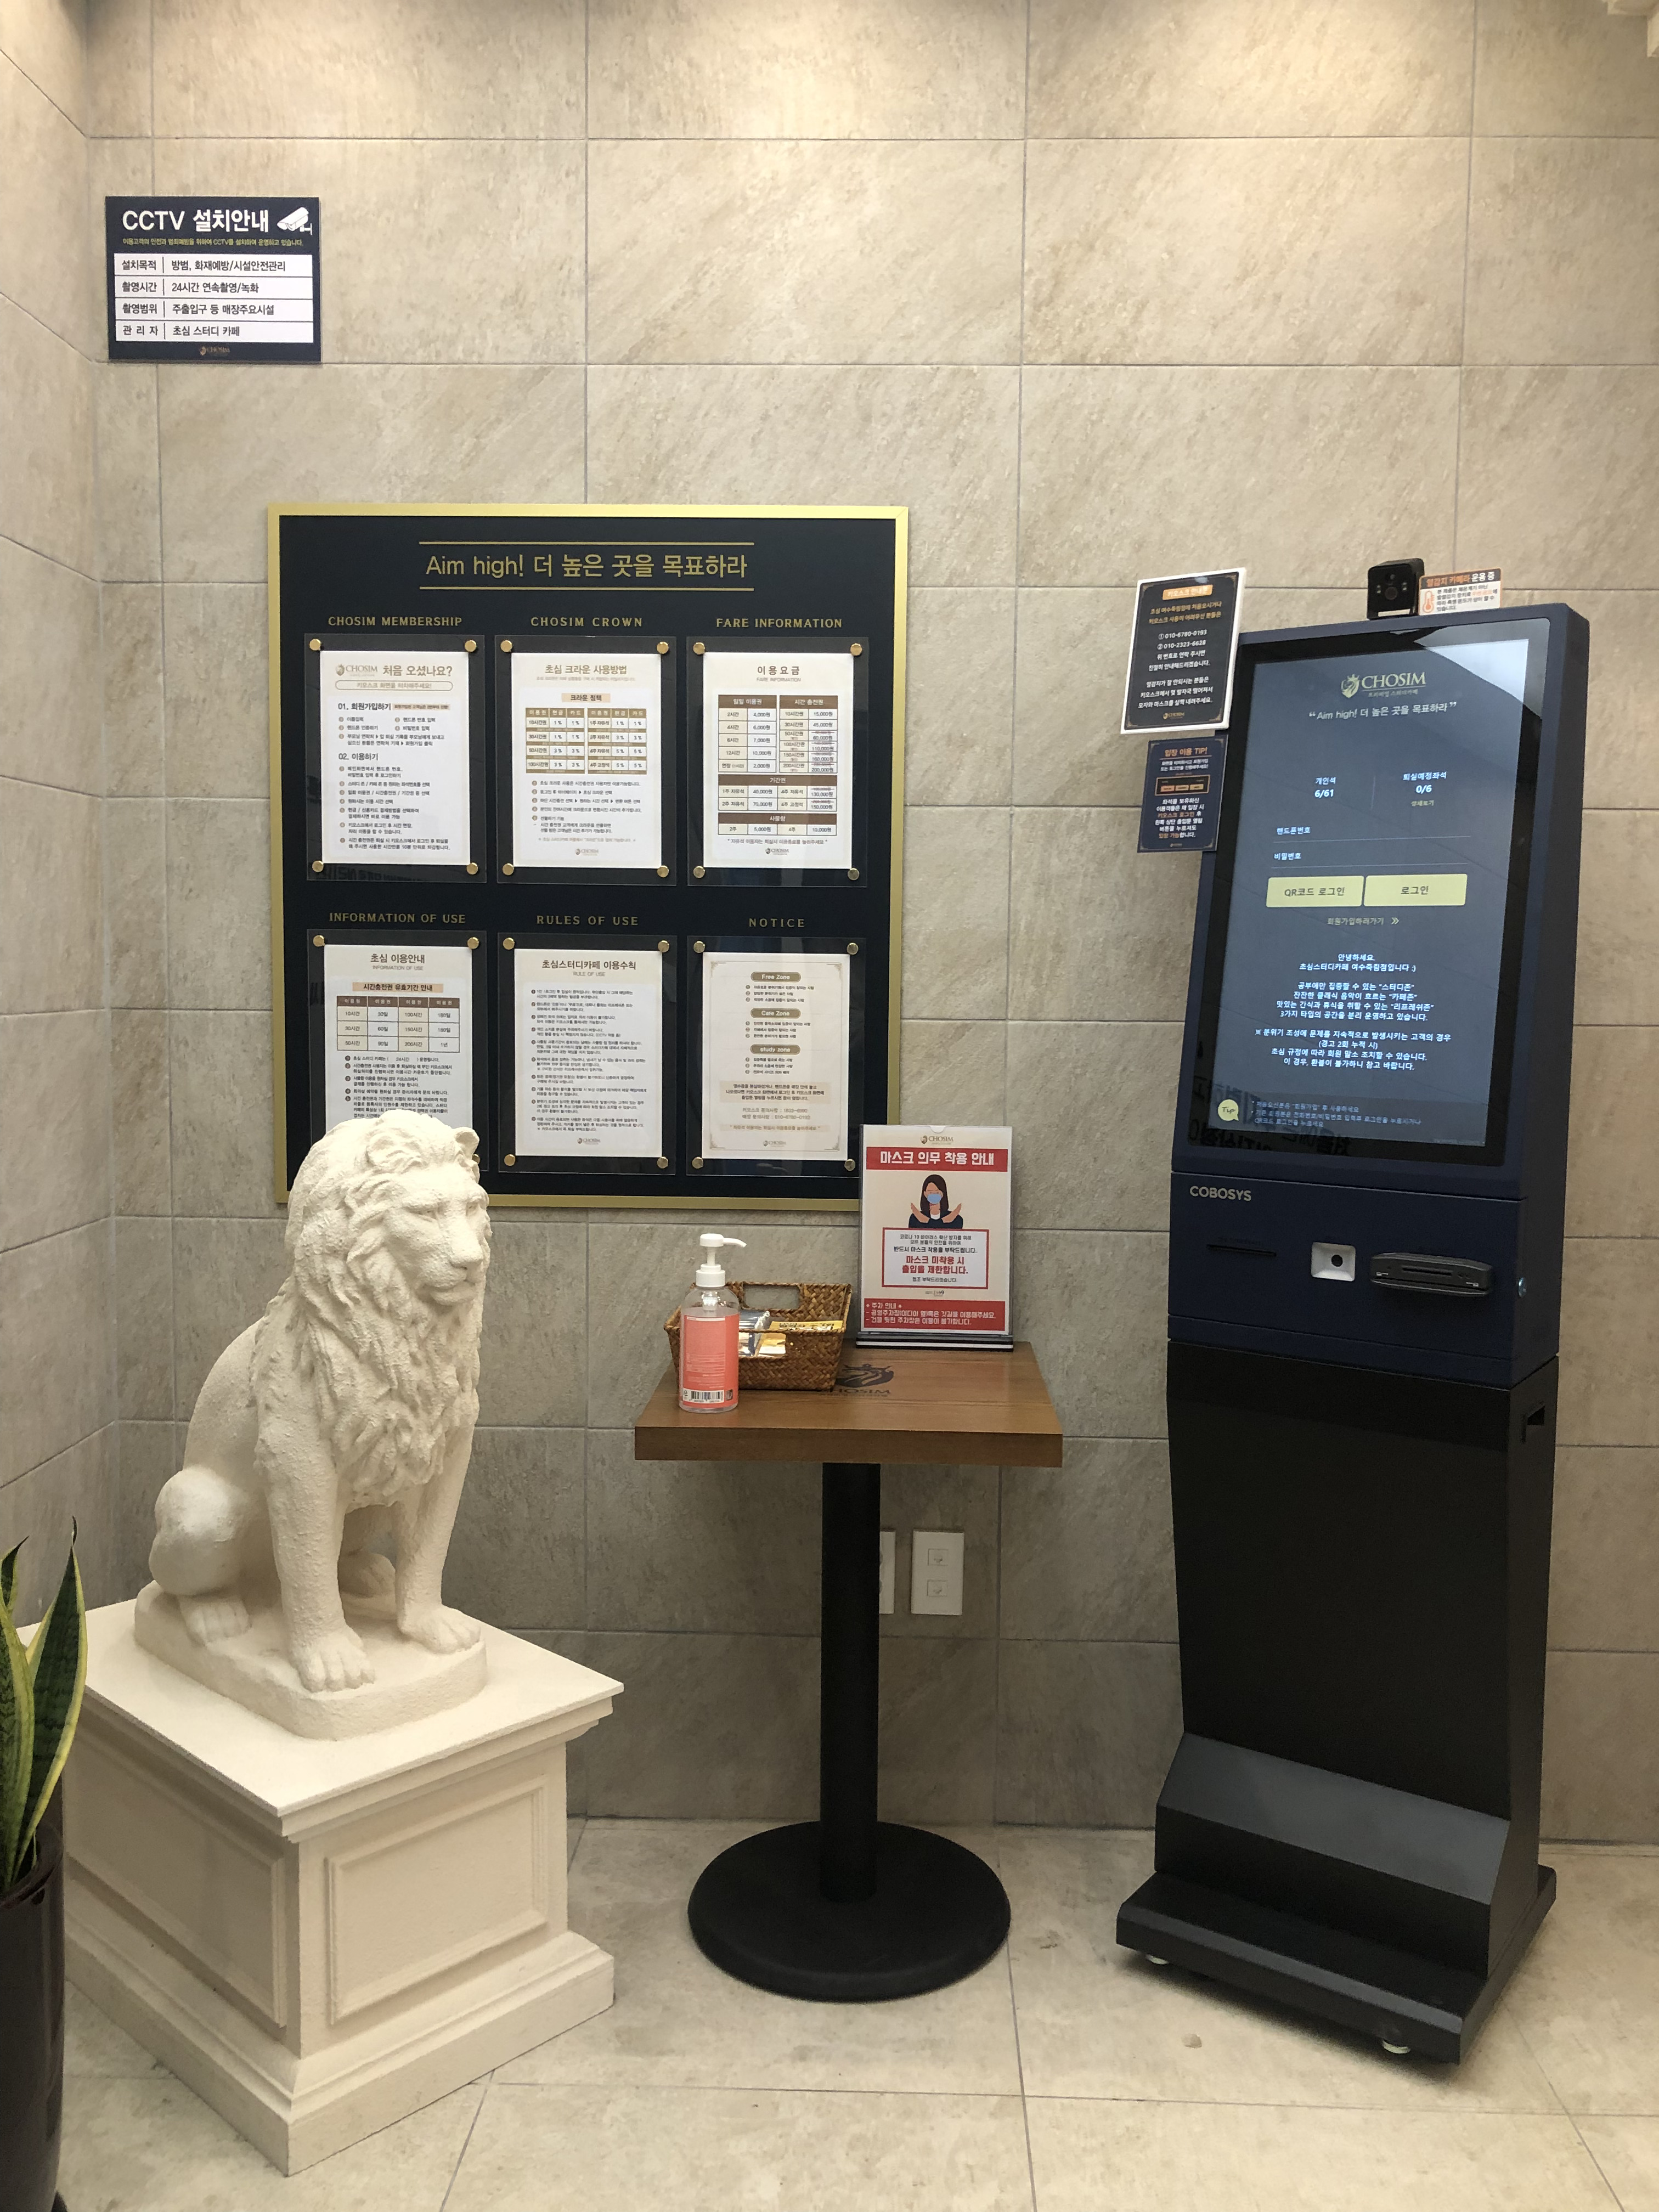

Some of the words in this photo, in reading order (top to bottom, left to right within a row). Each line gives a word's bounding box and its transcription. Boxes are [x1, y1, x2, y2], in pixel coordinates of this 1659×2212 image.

[122, 211, 184, 230] CCTV
[193, 210, 268, 232] 설치안내
[122, 260, 156, 270] 설치목적
[172, 261, 191, 271] 방범,
[195, 261, 285, 271] 화재예방/시설안전관리
[122, 283, 157, 292] 촬영시간
[172, 283, 199, 292] 24시간
[203, 283, 258, 293] 연속촬영/녹화
[123, 303, 157, 313] 촬영범위
[173, 304, 207, 314] 주출입구
[210, 305, 218, 314] 등
[222, 304, 274, 315] 매장주요시설
[173, 326, 190, 335] 초심
[193, 326, 219, 336] 스터디
[223, 327, 239, 336] 카페
[426, 556, 464, 575] Aim
[474, 555, 523, 578] high!
[535, 556, 552, 577] 더
[562, 554, 603, 578] 높은
[612, 555, 654, 578] 곳을
[663, 555, 748, 579] 목표하라
[328, 617, 375, 626] CHOSIM
[382, 617, 462, 626] MEMBERSHIP
[531, 617, 584, 627] CHOSIM
[592, 618, 642, 627] CROWN
[716, 618, 748, 628] FARE
[755, 618, 842, 628] INFORMATION
[383, 665, 402, 676] 처음
[407, 665, 452, 676] 오셨나요?
[545, 665, 562, 674] 초심
[565, 665, 590, 674] 크라운
[594, 665, 627, 675] 사용방법
[1361, 672, 1426, 689] CHOSIM
[1336, 709, 1357, 720] high!
[1361, 708, 1368, 717] 더
[1372, 707, 1388, 716] 높은
[1392, 706, 1409, 715] 곳을
[1403, 772, 1447, 781] 퇴실예정좌석
[1314, 789, 1334, 798] 6/61
[1416, 785, 1432, 794] 0/6
[1277, 827, 1310, 835] 핸드폰번호
[1285, 888, 1314, 896] QR코드
[1318, 887, 1345, 896] 로그인
[1401, 886, 1429, 895] 로그인
[330, 913, 415, 922] INFORMATION
[421, 914, 436, 923] OF
[443, 914, 466, 923] USE
[537, 915, 580, 924] RULES
[588, 916, 604, 925] OF
[613, 917, 638, 926] USE
[749, 918, 804, 927] NOTICE
[1327, 917, 1384, 926] 회원가입하러가기
[371, 954, 387, 963] 초심
[391, 954, 425, 964] 이용안내
[542, 960, 600, 969] 초심스터디카페
[604, 961, 636, 969] 이용수칙
[1352, 963, 1409, 972] 여수죽림점입니다
[1397, 1013, 1427, 1021] 있습니다.
[1372, 1032, 1408, 1040] 발생시키는
[1410, 1032, 1433, 1041] 고객의
[1396, 1052, 1427, 1060] 있습니다.
[1222, 1106, 1236, 1114] Tip
[881, 1152, 913, 1164] 마스크
[918, 1152, 940, 1164] 의무
[945, 1152, 967, 1165] 착용
[972, 1153, 994, 1165] 안내
[1190, 1186, 1251, 1201] COBOSYS
[933, 1256, 954, 1265] 미착용
[928, 1266, 968, 1274] 제한합니다.
